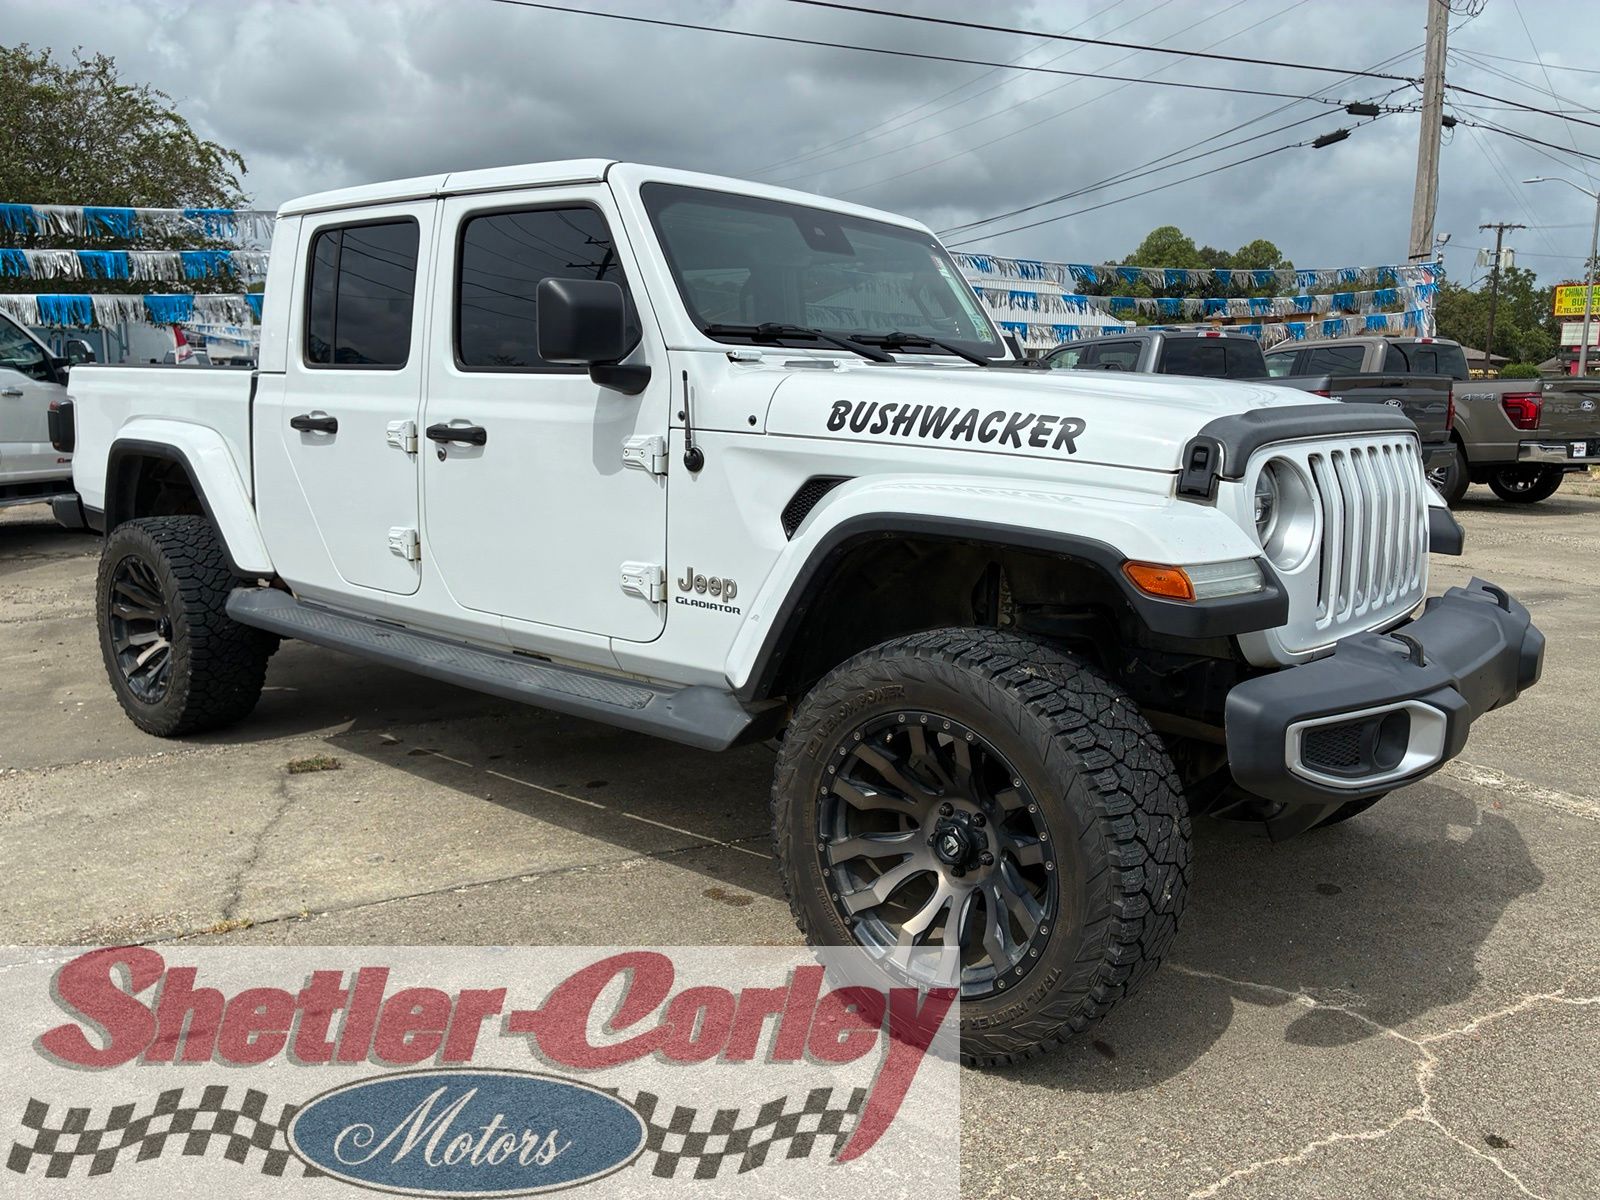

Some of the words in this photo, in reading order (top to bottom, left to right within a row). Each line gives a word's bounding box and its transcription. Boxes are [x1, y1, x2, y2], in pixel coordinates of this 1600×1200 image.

[826, 400, 1087, 455] BUSHWACKER
[678, 566, 738, 603] Jeep
[675, 596, 741, 615] GLADIATOR
[857, 684, 905, 708] POWER
[1024, 963, 1063, 1009] TRAIL
[968, 999, 1030, 1032] HUNTER
